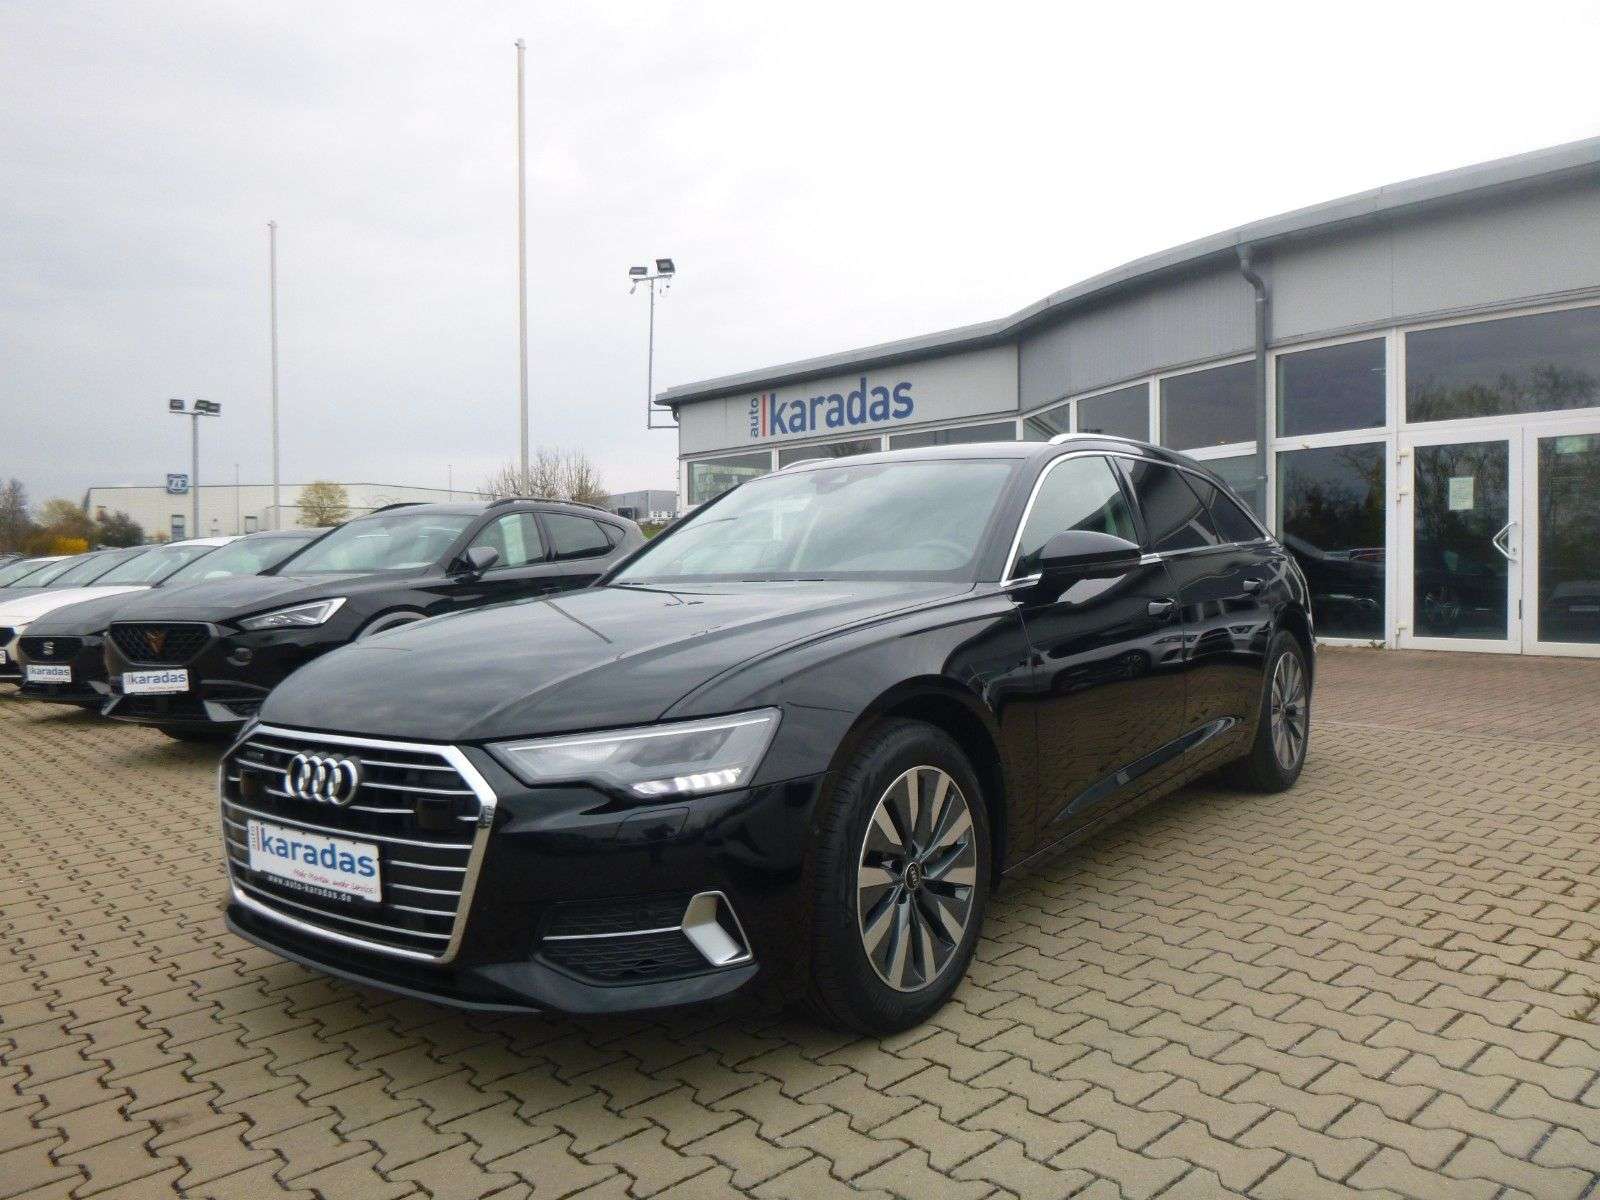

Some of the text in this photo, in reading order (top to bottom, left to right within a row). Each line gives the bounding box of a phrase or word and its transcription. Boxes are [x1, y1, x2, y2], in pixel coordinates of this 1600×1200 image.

[750, 397, 759, 438] auto
[769, 377, 914, 436] karadas
[131, 672, 187, 684] karadas
[261, 826, 376, 878] karadas
